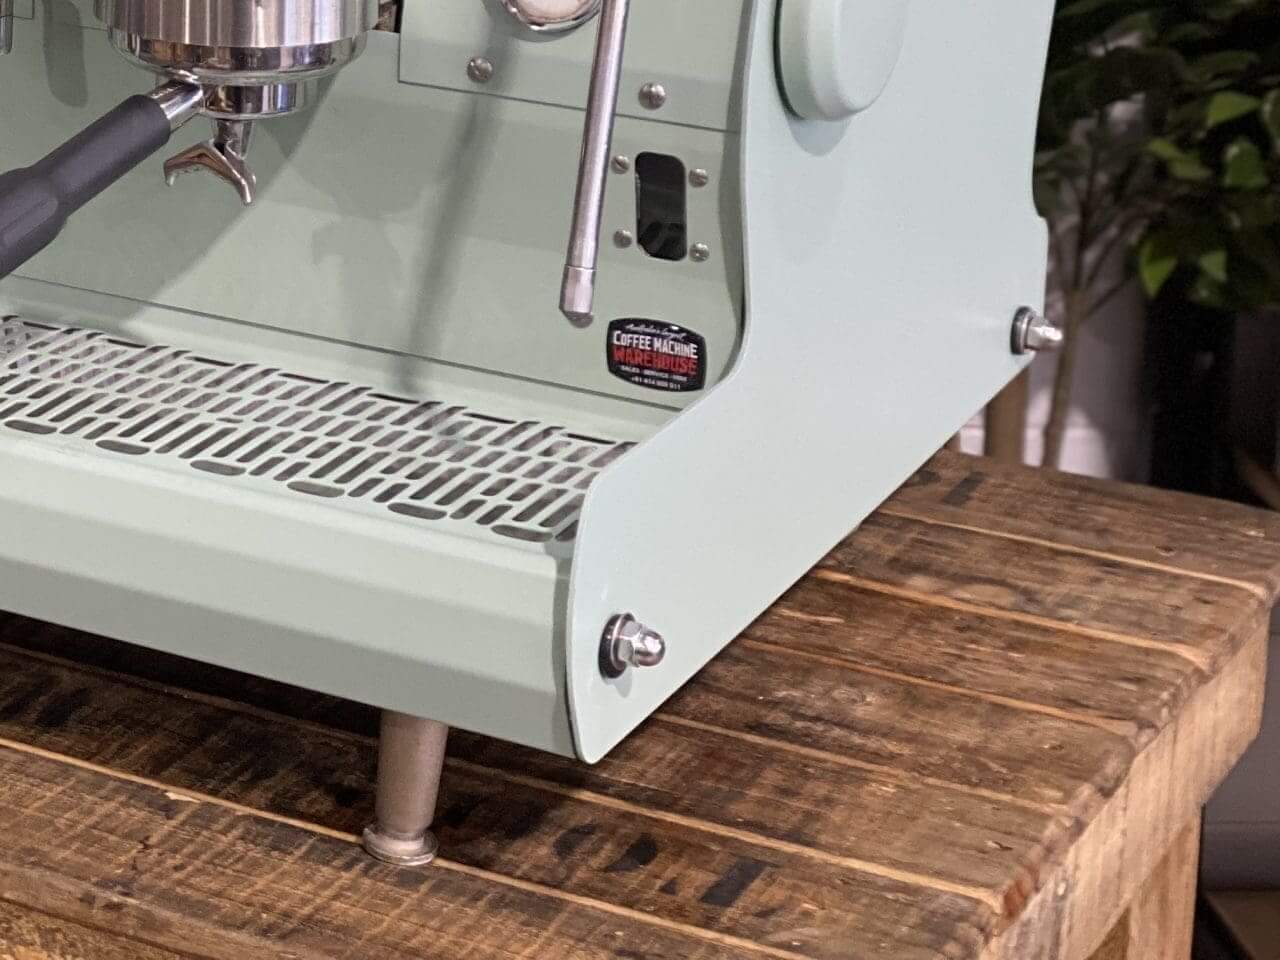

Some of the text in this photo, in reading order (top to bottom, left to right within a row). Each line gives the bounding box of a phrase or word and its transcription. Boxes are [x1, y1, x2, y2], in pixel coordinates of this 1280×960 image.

[613, 330, 699, 359] COFFEE MACHINE
[614, 346, 698, 375] WAREHOUSE
